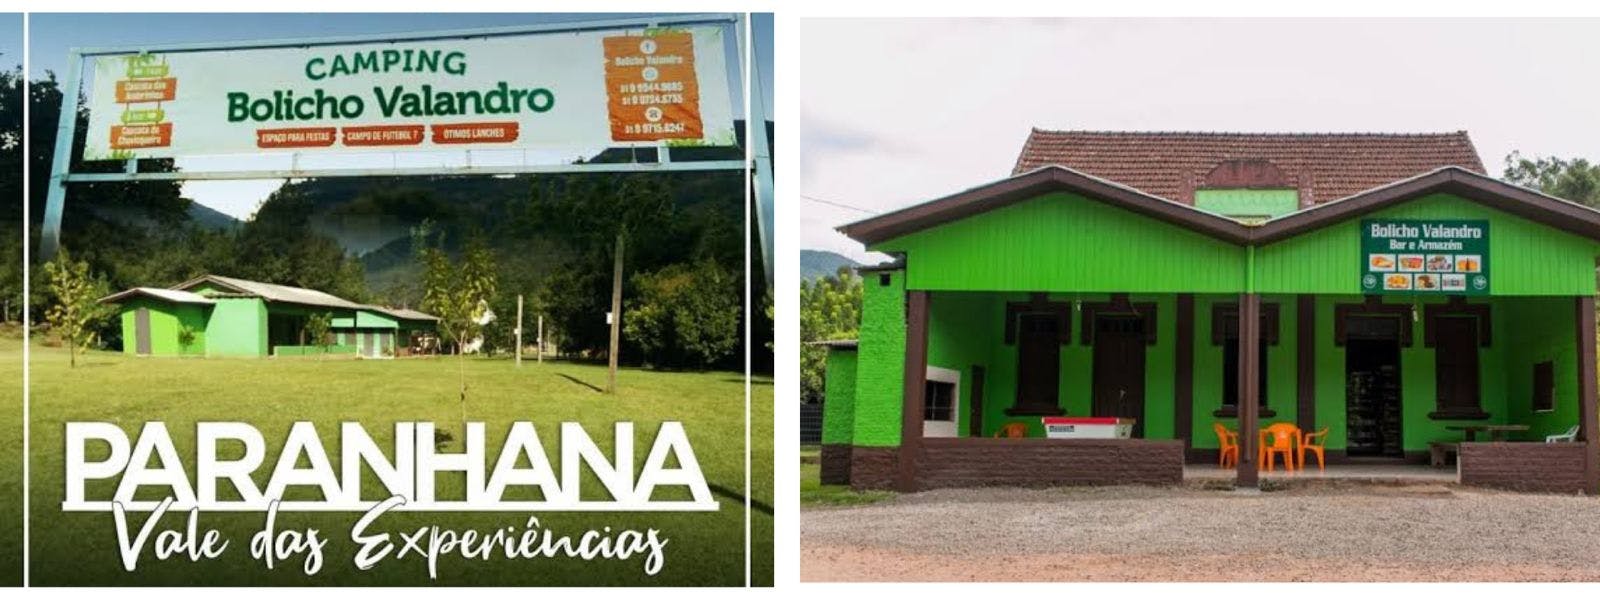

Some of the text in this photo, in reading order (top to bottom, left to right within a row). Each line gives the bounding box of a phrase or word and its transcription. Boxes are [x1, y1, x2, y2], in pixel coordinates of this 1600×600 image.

[305, 49, 467, 81] CAMPING
[227, 82, 556, 122] Bolicho Valandro
[373, 131, 382, 141] DE
[1371, 223, 1482, 239] Bolicho Valandro
[1389, 239, 1463, 250] Bar e Armazém
